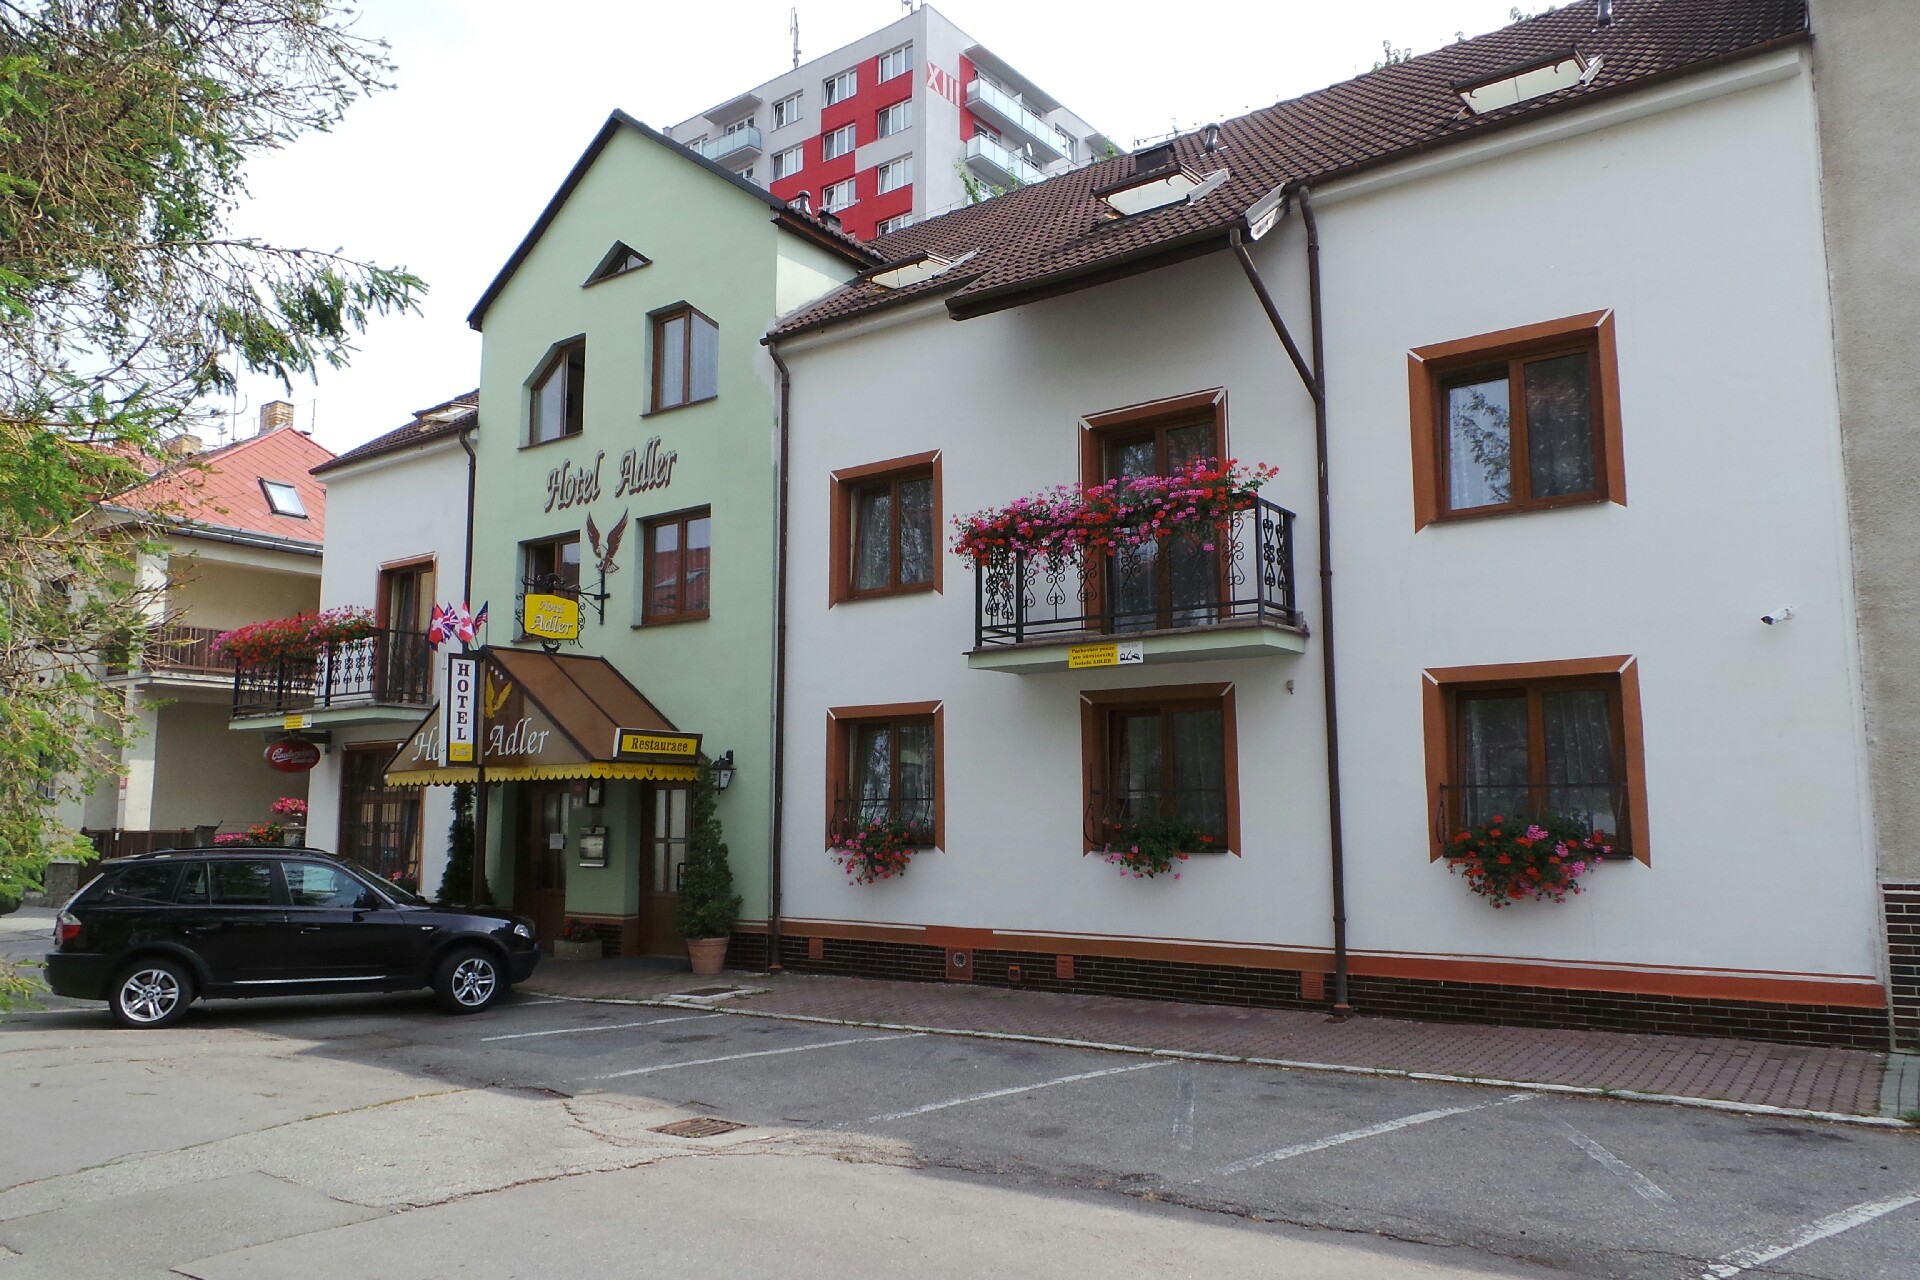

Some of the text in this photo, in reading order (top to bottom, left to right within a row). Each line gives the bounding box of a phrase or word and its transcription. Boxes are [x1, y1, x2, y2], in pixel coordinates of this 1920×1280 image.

[544, 436, 678, 513] Hotel Adler
[539, 601, 566, 613] Hotel
[531, 614, 573, 634] Adler
[456, 663, 470, 740] HOTEL
[485, 718, 549, 756] Adler
[631, 738, 688, 752] Restaurace
